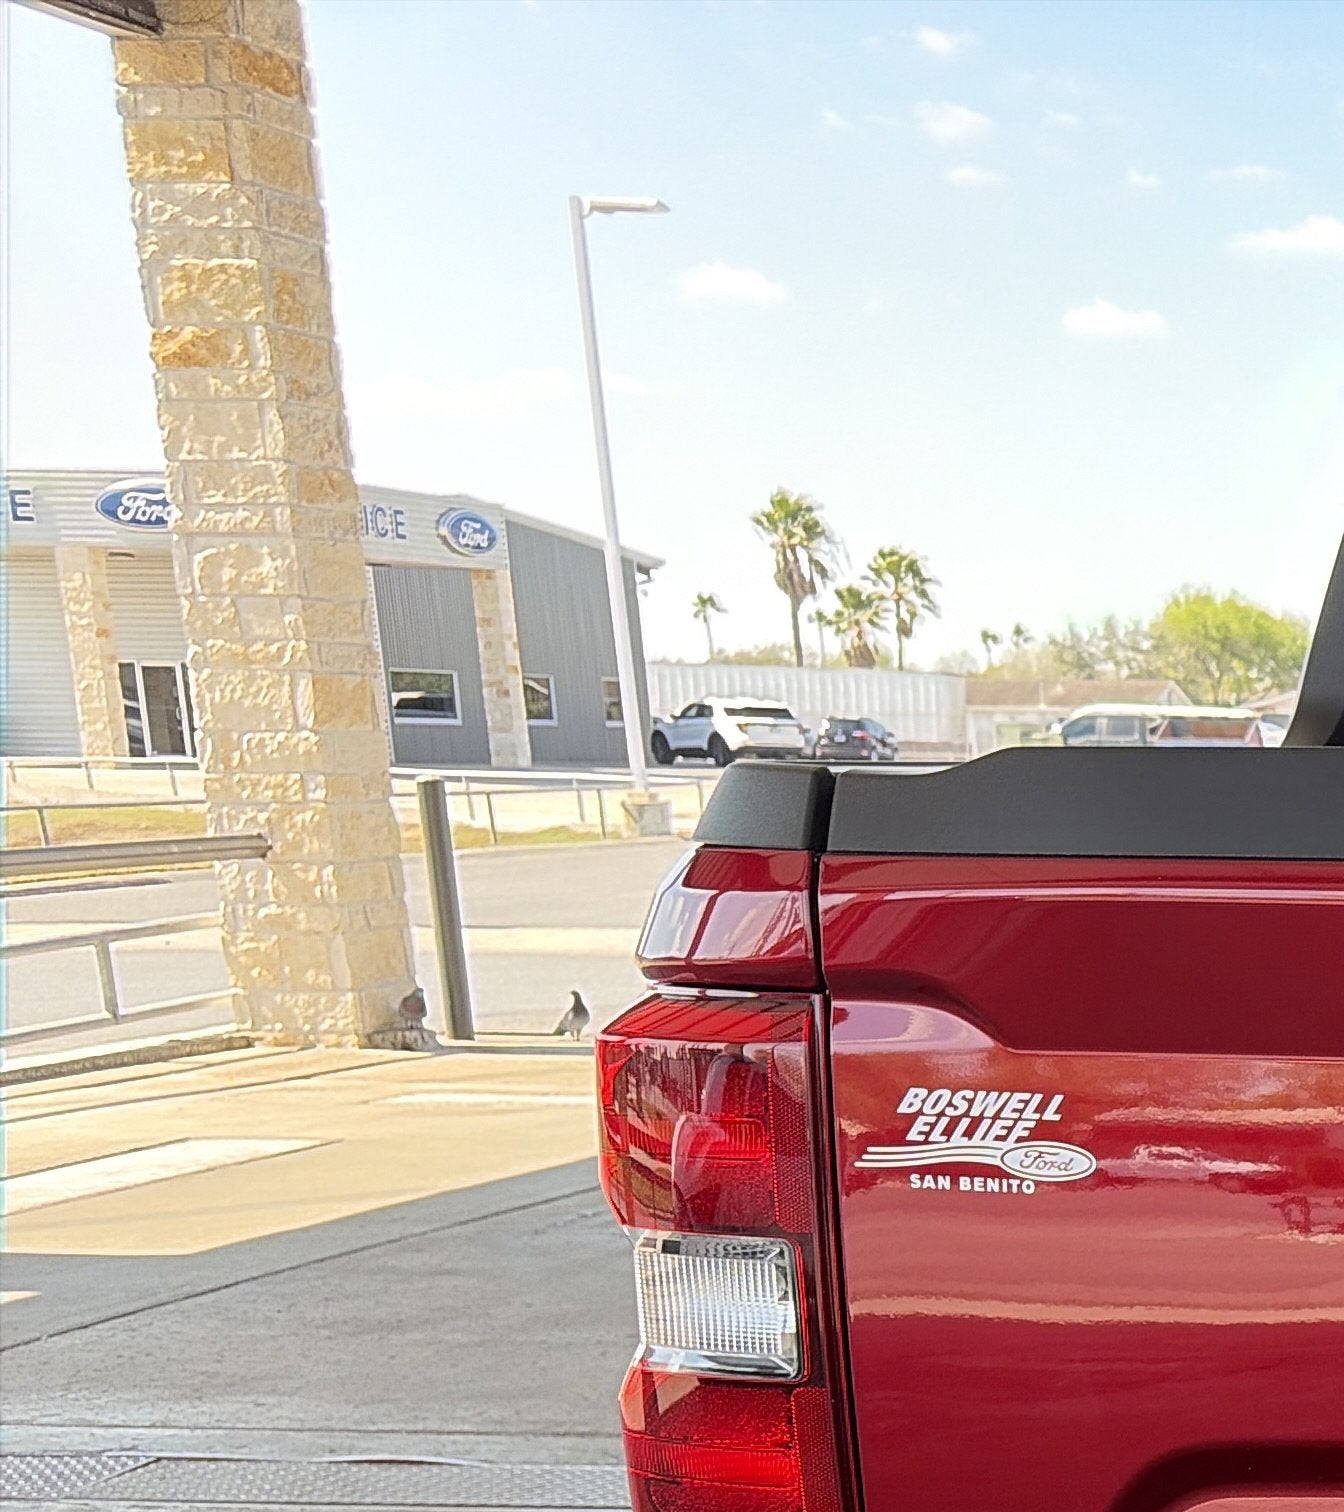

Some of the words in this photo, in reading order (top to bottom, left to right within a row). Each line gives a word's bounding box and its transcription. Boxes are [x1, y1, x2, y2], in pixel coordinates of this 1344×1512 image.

[458, 519, 489, 548] Ford
[896, 1086, 1065, 1121] BOSWELL
[905, 1115, 1037, 1144] ELLIFF
[1018, 1150, 1074, 1172] Ford
[910, 1173, 951, 1190] SAN
[959, 1176, 1036, 1194] BENITO
